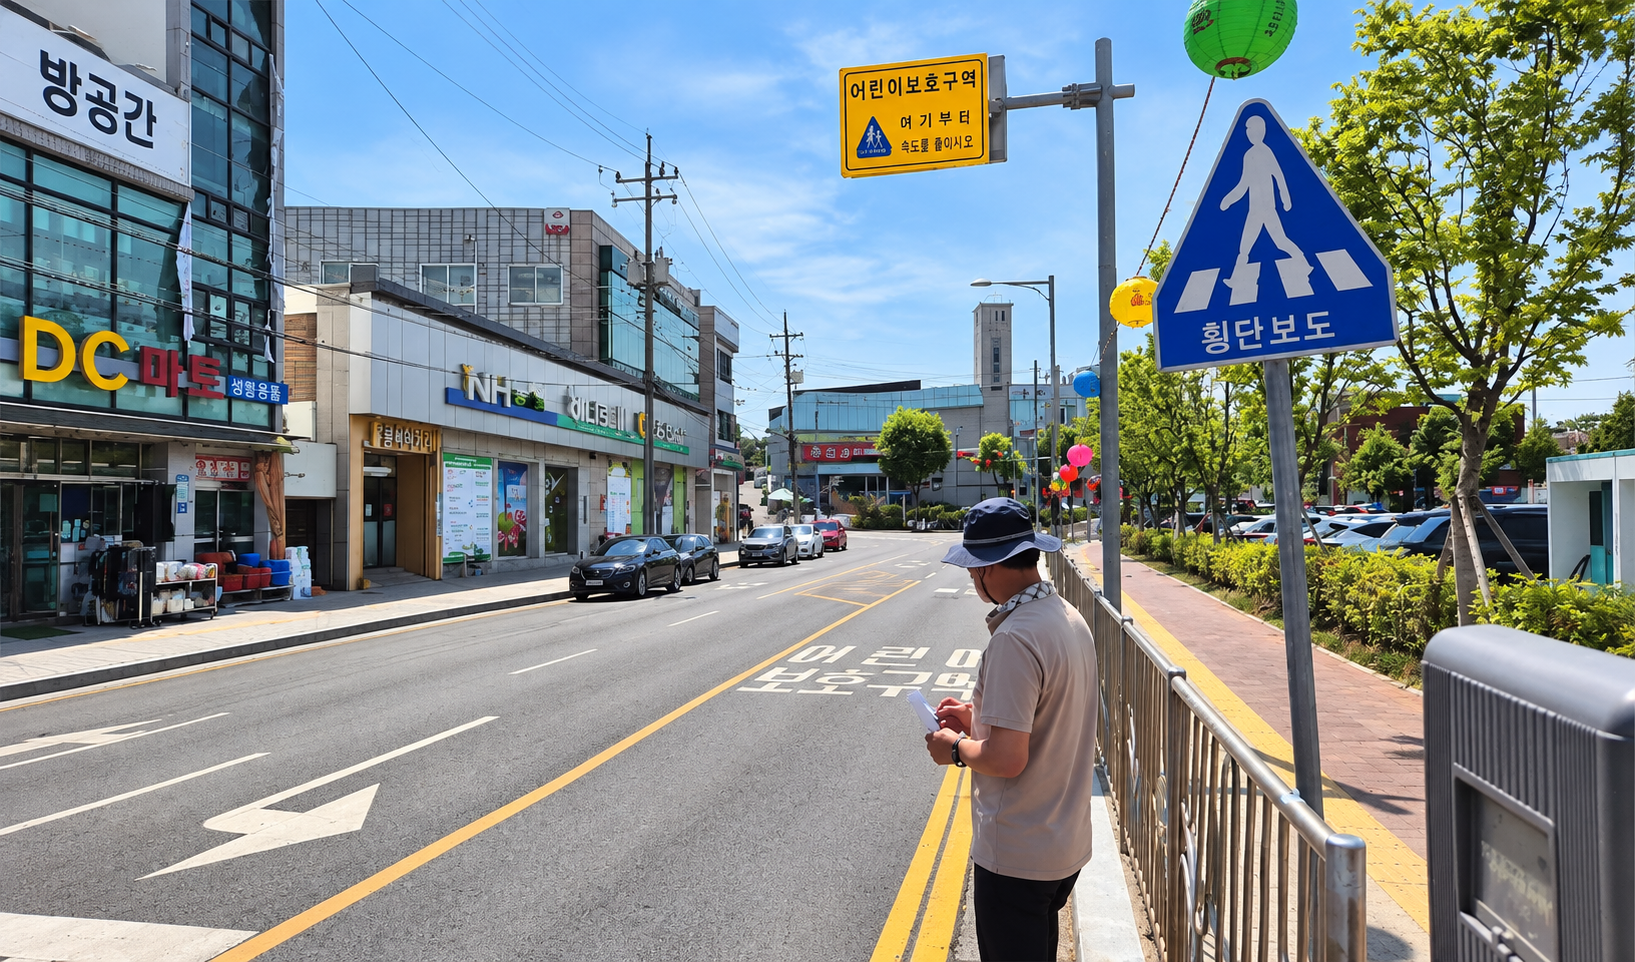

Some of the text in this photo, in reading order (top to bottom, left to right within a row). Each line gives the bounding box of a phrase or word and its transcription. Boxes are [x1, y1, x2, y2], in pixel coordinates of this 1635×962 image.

[40, 49, 157, 149] 방공간
[850, 69, 976, 101] 어린이보호구역
[1201, 310, 1336, 355] 횡단보도
